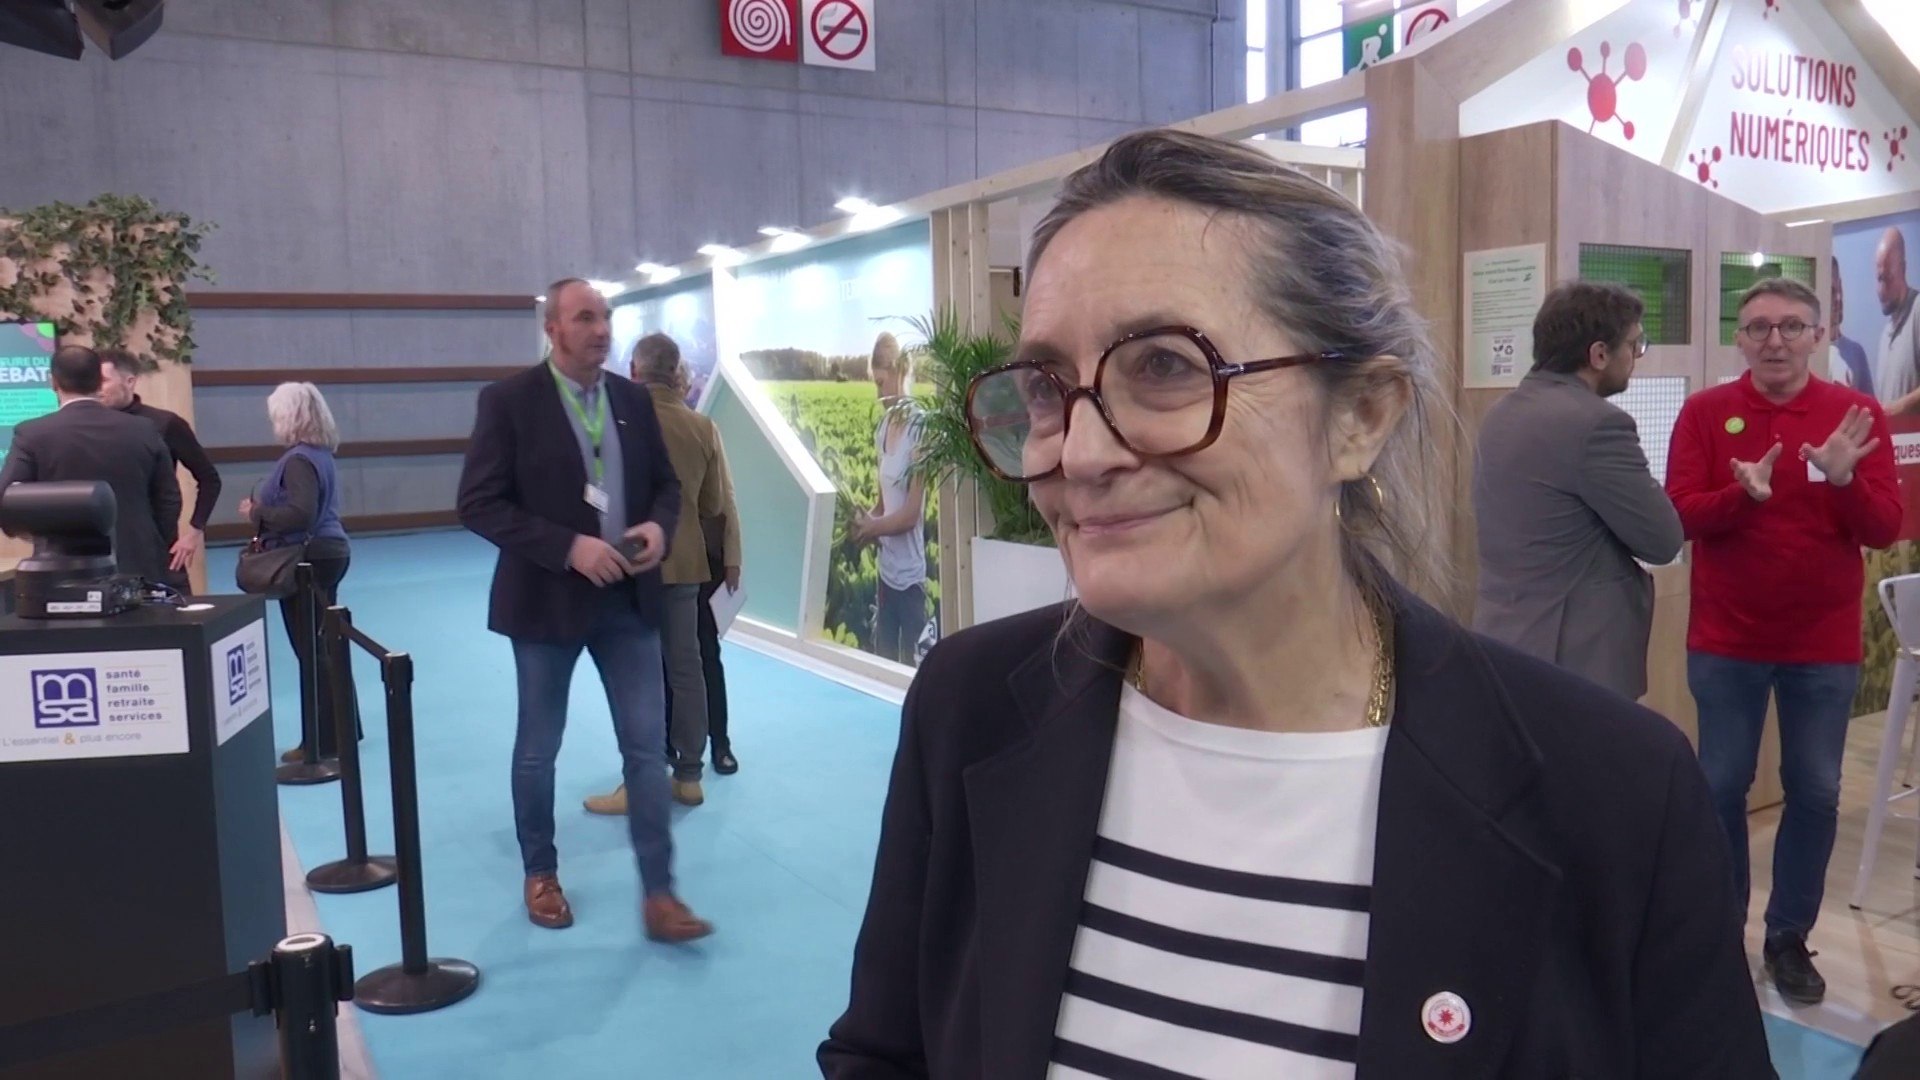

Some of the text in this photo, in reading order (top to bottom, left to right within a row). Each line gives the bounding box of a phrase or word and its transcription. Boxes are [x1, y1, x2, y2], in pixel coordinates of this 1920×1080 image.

[1732, 44, 1857, 108] SOLUTIONS
[1730, 109, 1870, 173] NUMÉRIQUES
[106, 669, 141, 679] santé
[106, 683, 150, 693] famille
[107, 698, 155, 707] retraite
[109, 712, 162, 721] services
[63, 732, 76, 745] &
[104, 731, 142, 742] encore
